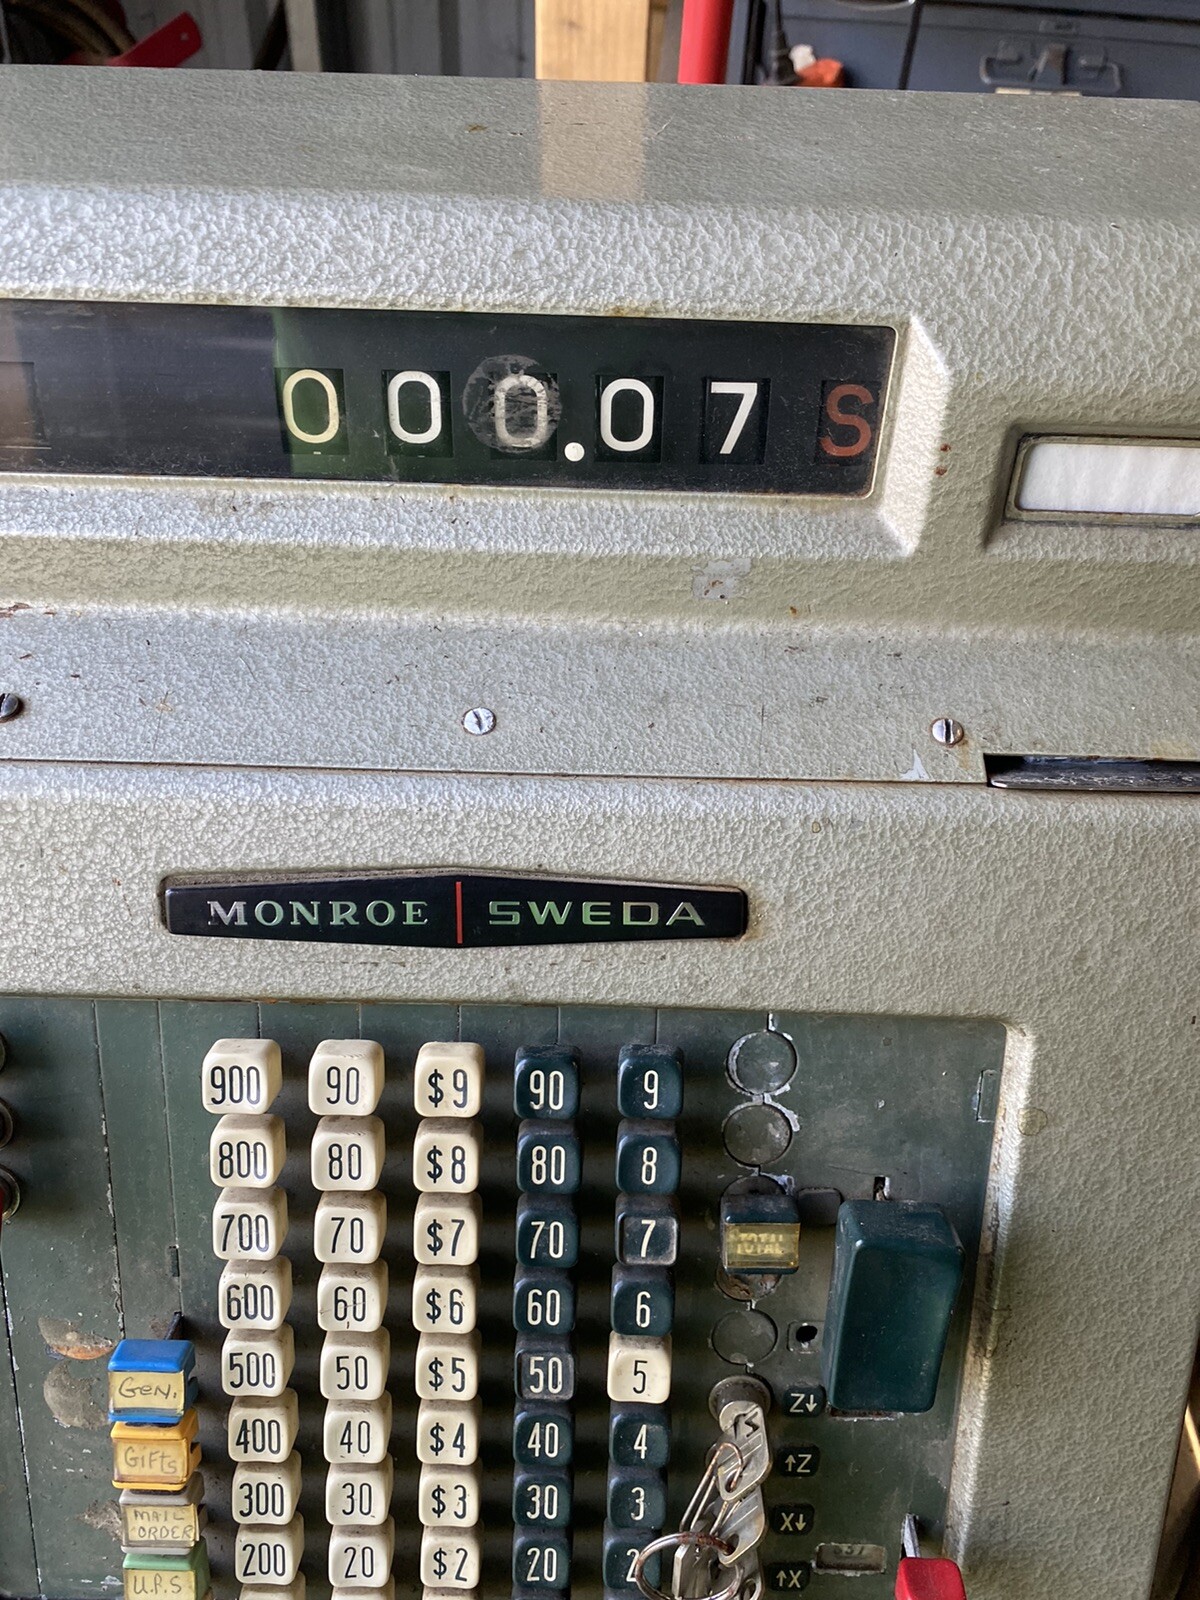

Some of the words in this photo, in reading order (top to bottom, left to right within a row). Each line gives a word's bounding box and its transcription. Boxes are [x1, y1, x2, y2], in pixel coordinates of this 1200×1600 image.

[206, 901, 430, 927] MONROE
[488, 901, 707, 927] SWEDA
[210, 1065, 261, 1105] 900
[326, 1066, 360, 1105] 90
[529, 1070, 564, 1110] 90
[643, 1070, 659, 1110] 9
[218, 1141, 267, 1180] 800
[328, 1143, 362, 1181] 80
[531, 1145, 566, 1185] 80
[641, 1147, 658, 1185] 8
[220, 1214, 269, 1253] 700
[330, 1217, 364, 1254] 70
[530, 1221, 564, 1259] 70
[640, 1219, 656, 1258] 7
[226, 1284, 274, 1322] 600
[333, 1286, 367, 1322] 60
[527, 1289, 561, 1326] 60
[635, 1291, 651, 1328] 6
[228, 1352, 276, 1389] 500
[336, 1355, 369, 1391] 50
[529, 1356, 563, 1394] 50
[632, 1360, 648, 1394] 5
[235, 1418, 281, 1455] 400
[339, 1420, 371, 1454] 40
[527, 1422, 559, 1458] 40
[633, 1424, 648, 1460] 4
[238, 1482, 285, 1518] 300
[341, 1482, 373, 1516] 30
[526, 1485, 558, 1520] 30
[630, 1487, 645, 1521] 3
[137, 1525, 194, 1541] ORDER
[241, 1543, 286, 1578] 200
[343, 1546, 374, 1579] 20
[526, 1547, 558, 1582] 20
